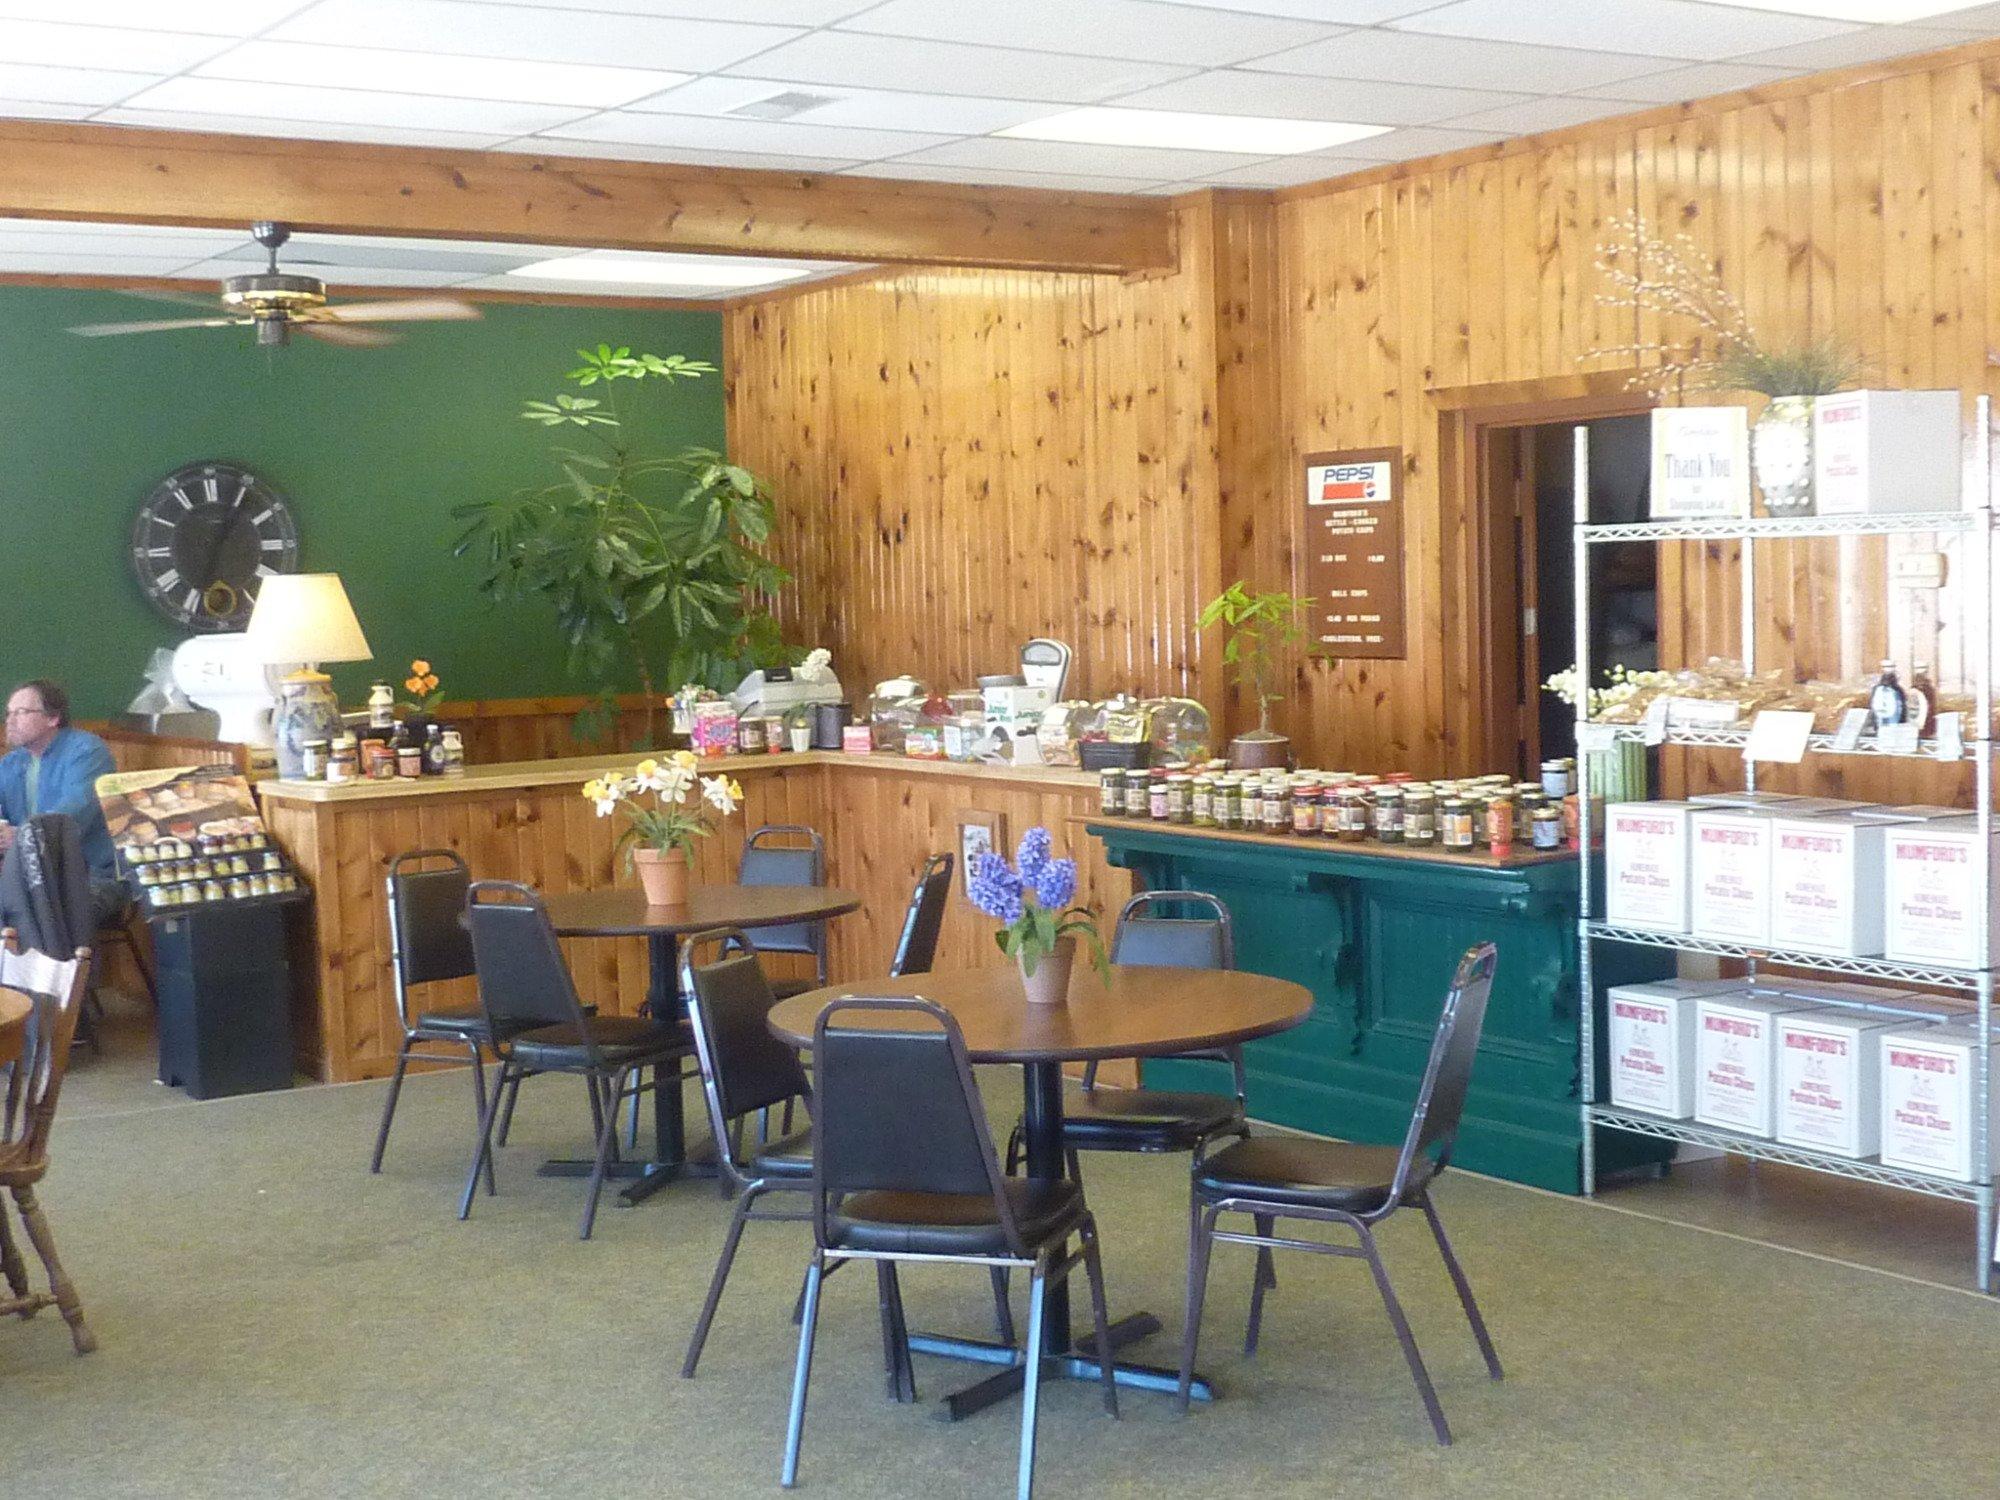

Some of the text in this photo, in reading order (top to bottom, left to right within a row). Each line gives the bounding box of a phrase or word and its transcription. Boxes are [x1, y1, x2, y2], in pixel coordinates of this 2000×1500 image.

[1324, 466, 1375, 482] PEPSI
[1665, 452, 1731, 478] Thank You
[1616, 818, 1675, 836] MUMFORD'S
[1701, 828, 1759, 846] MUMFORD'S
[1781, 834, 1843, 853] MUMFORD'S
[1896, 844, 1967, 864] MUMFORD'S
